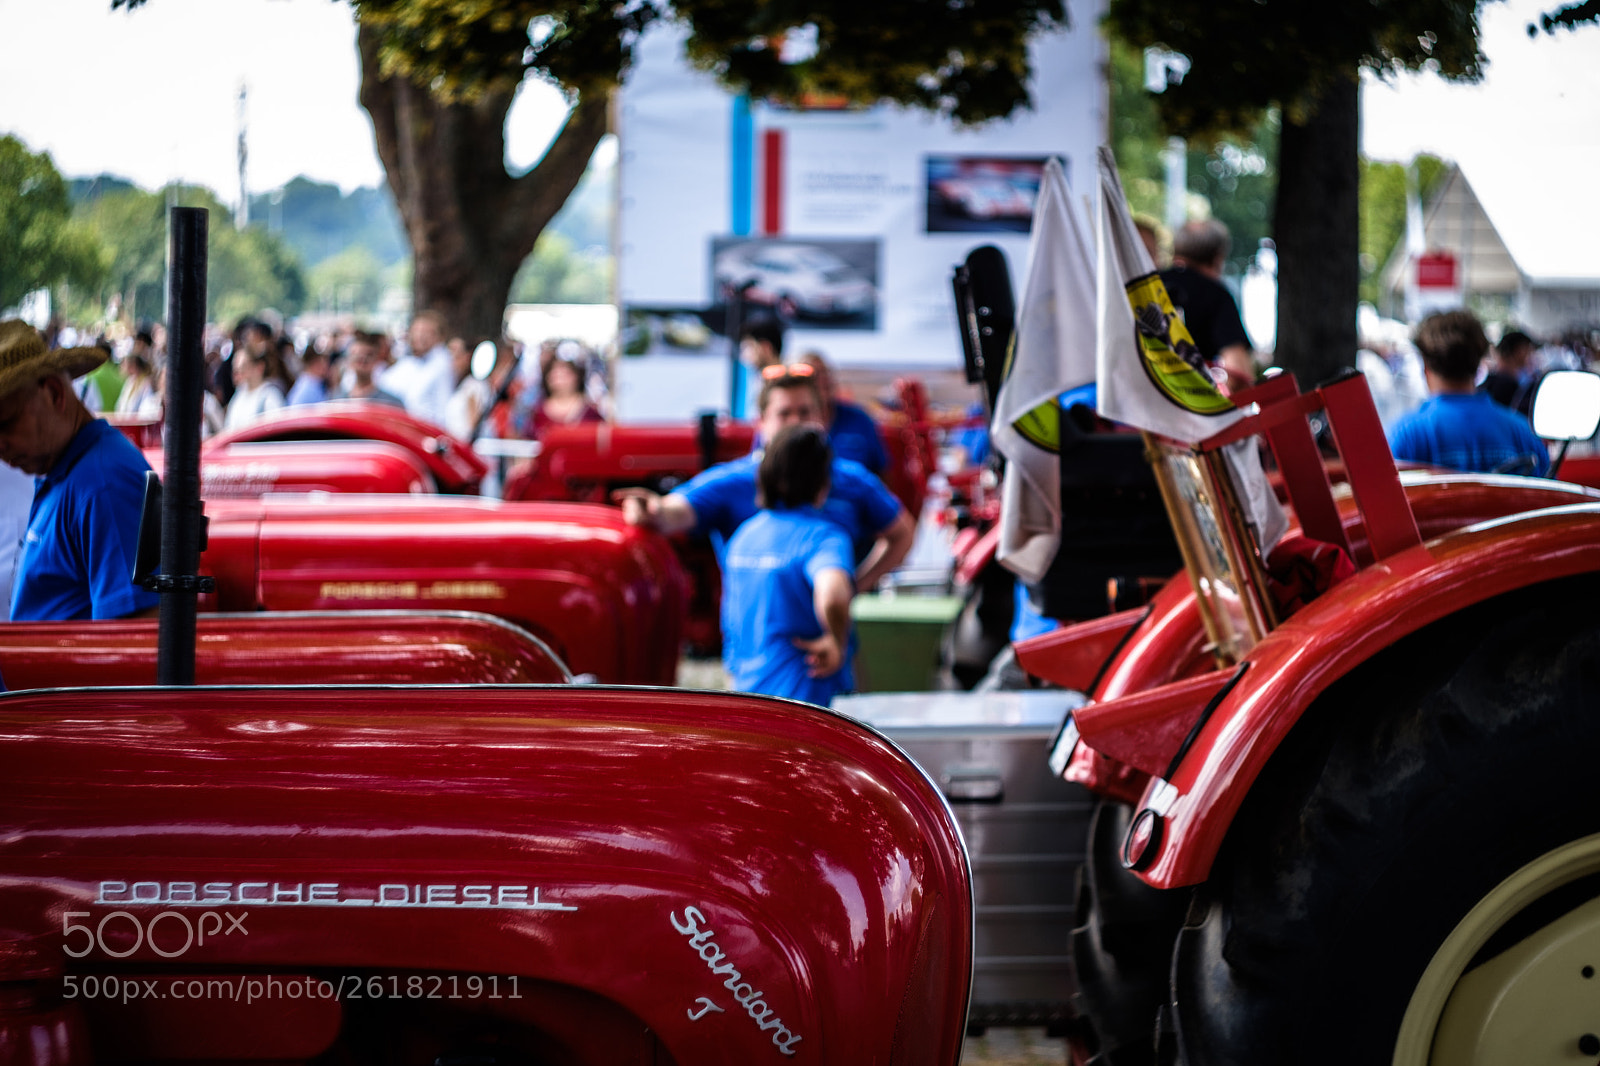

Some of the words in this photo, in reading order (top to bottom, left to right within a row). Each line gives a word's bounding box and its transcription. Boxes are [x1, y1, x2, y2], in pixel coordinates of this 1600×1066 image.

[96, 881, 360, 906] PORSCHE
[374, 883, 578, 911] DIESEL
[669, 905, 802, 1055] Standard
